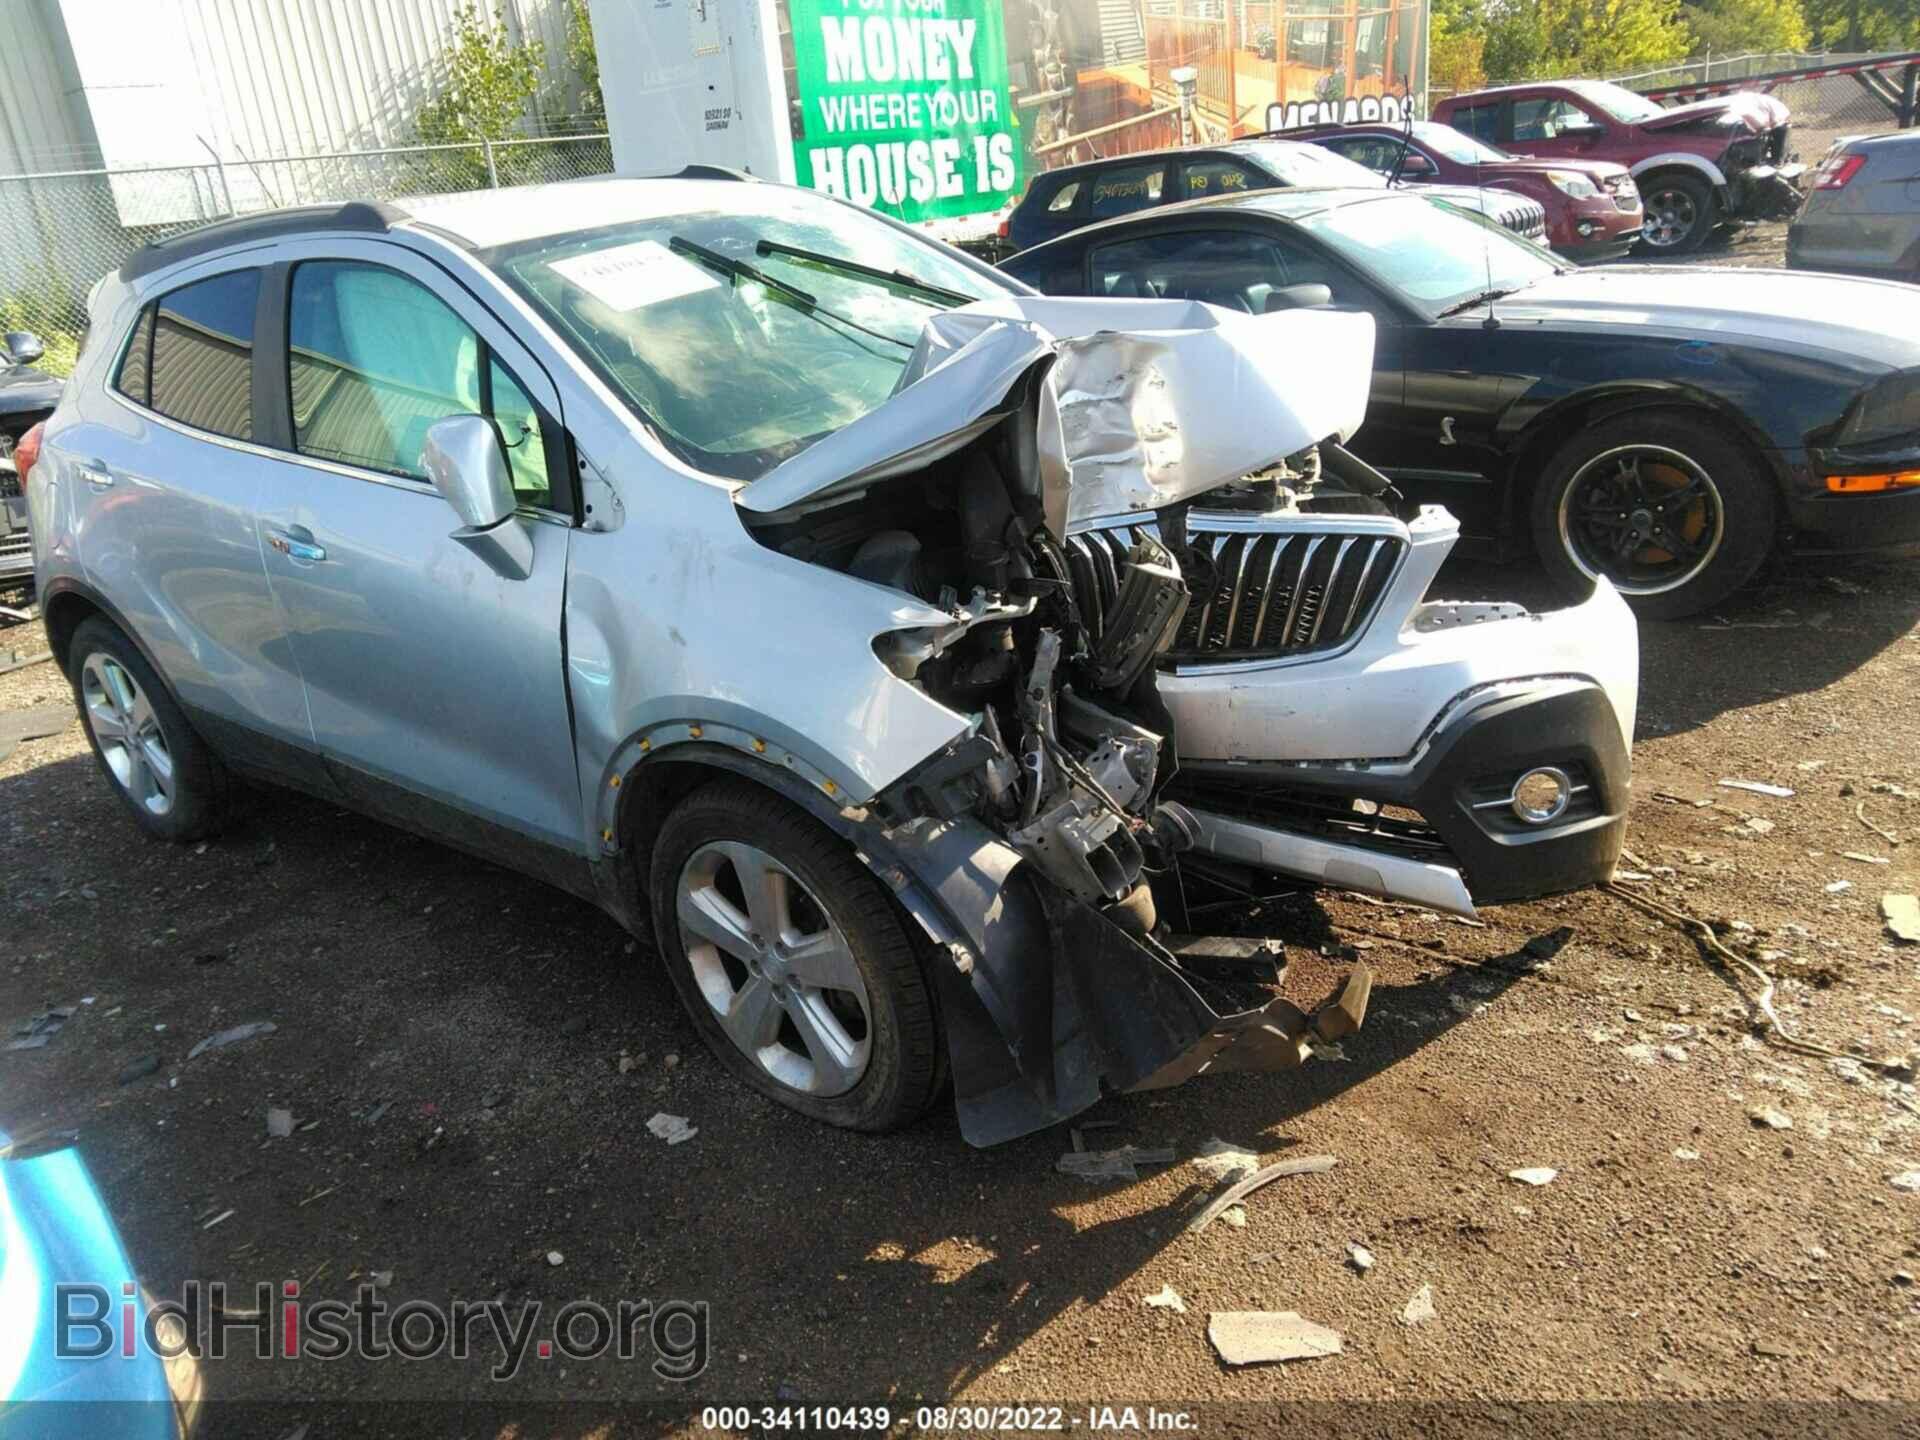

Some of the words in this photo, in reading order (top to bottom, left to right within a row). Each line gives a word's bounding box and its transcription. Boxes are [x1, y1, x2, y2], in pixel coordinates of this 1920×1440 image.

[820, 15, 976, 83] MONEY
[818, 92, 925, 133] WHERE
[924, 89, 998, 128] YOUR
[809, 138, 964, 208] HOUSE
[974, 133, 1016, 193] IS
